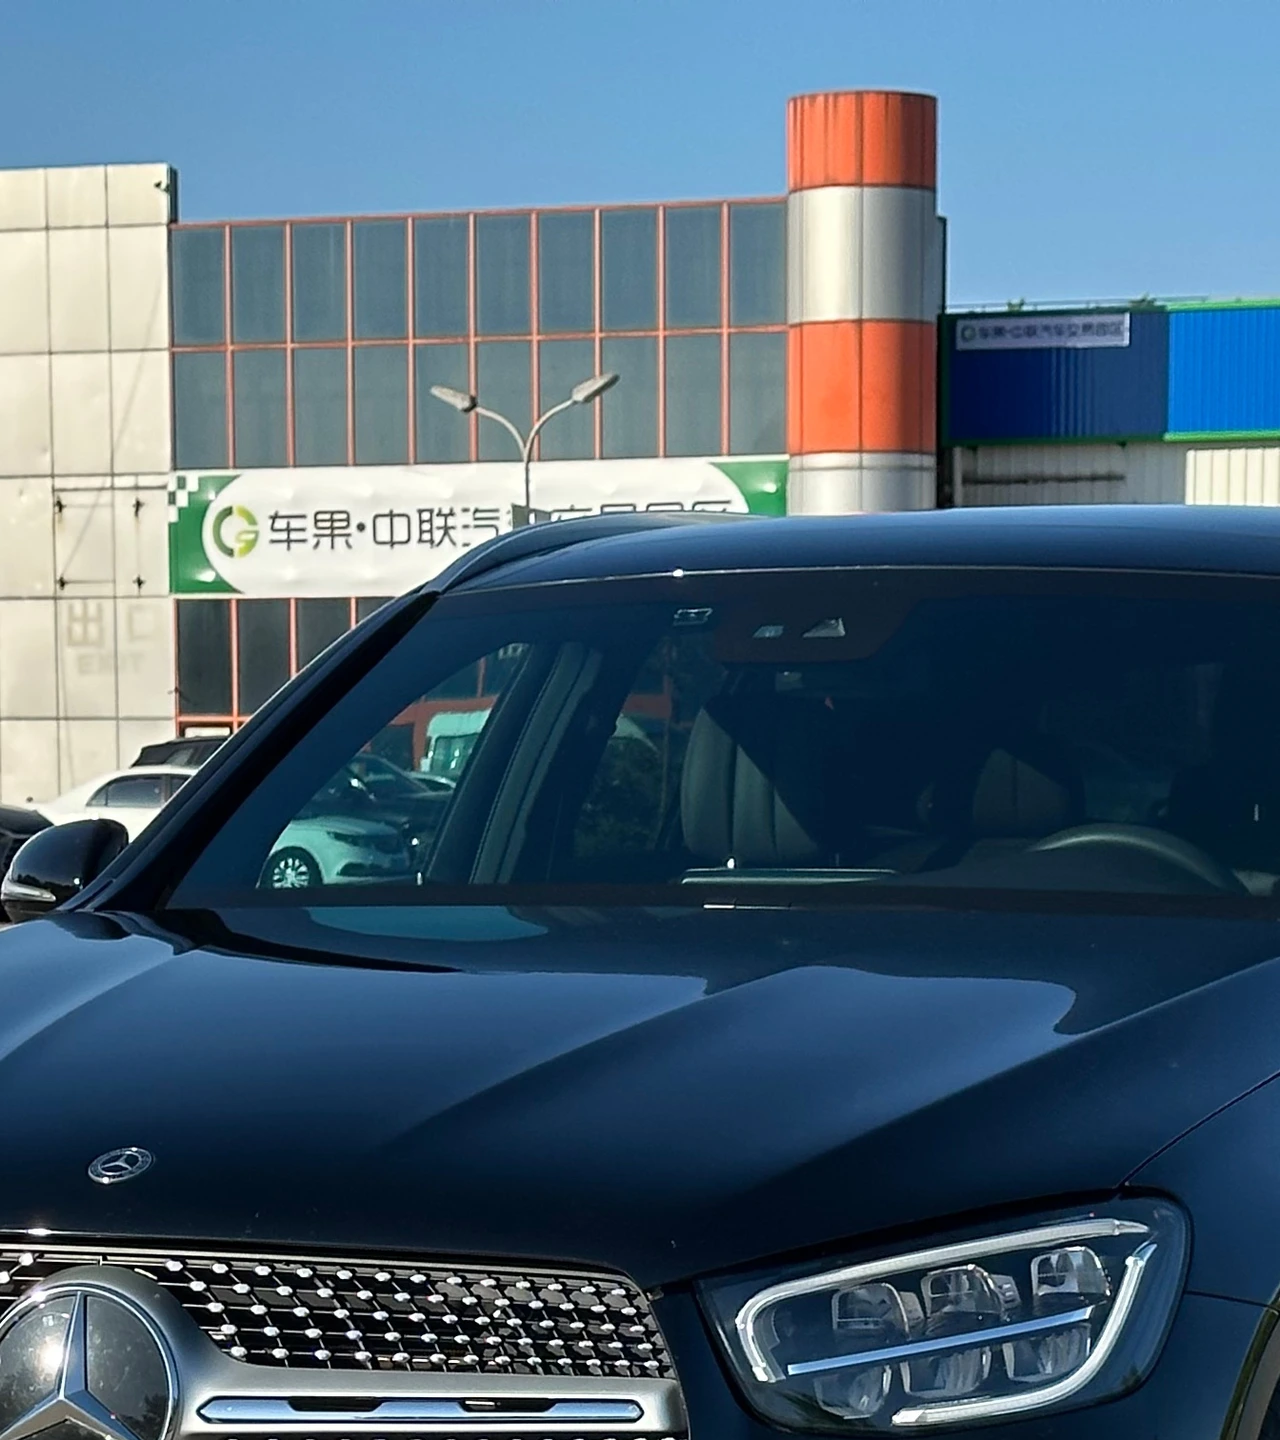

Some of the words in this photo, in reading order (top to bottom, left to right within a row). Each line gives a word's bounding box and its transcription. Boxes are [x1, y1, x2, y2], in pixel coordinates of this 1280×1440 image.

[268, 499, 732, 551] 车果·中联汽
